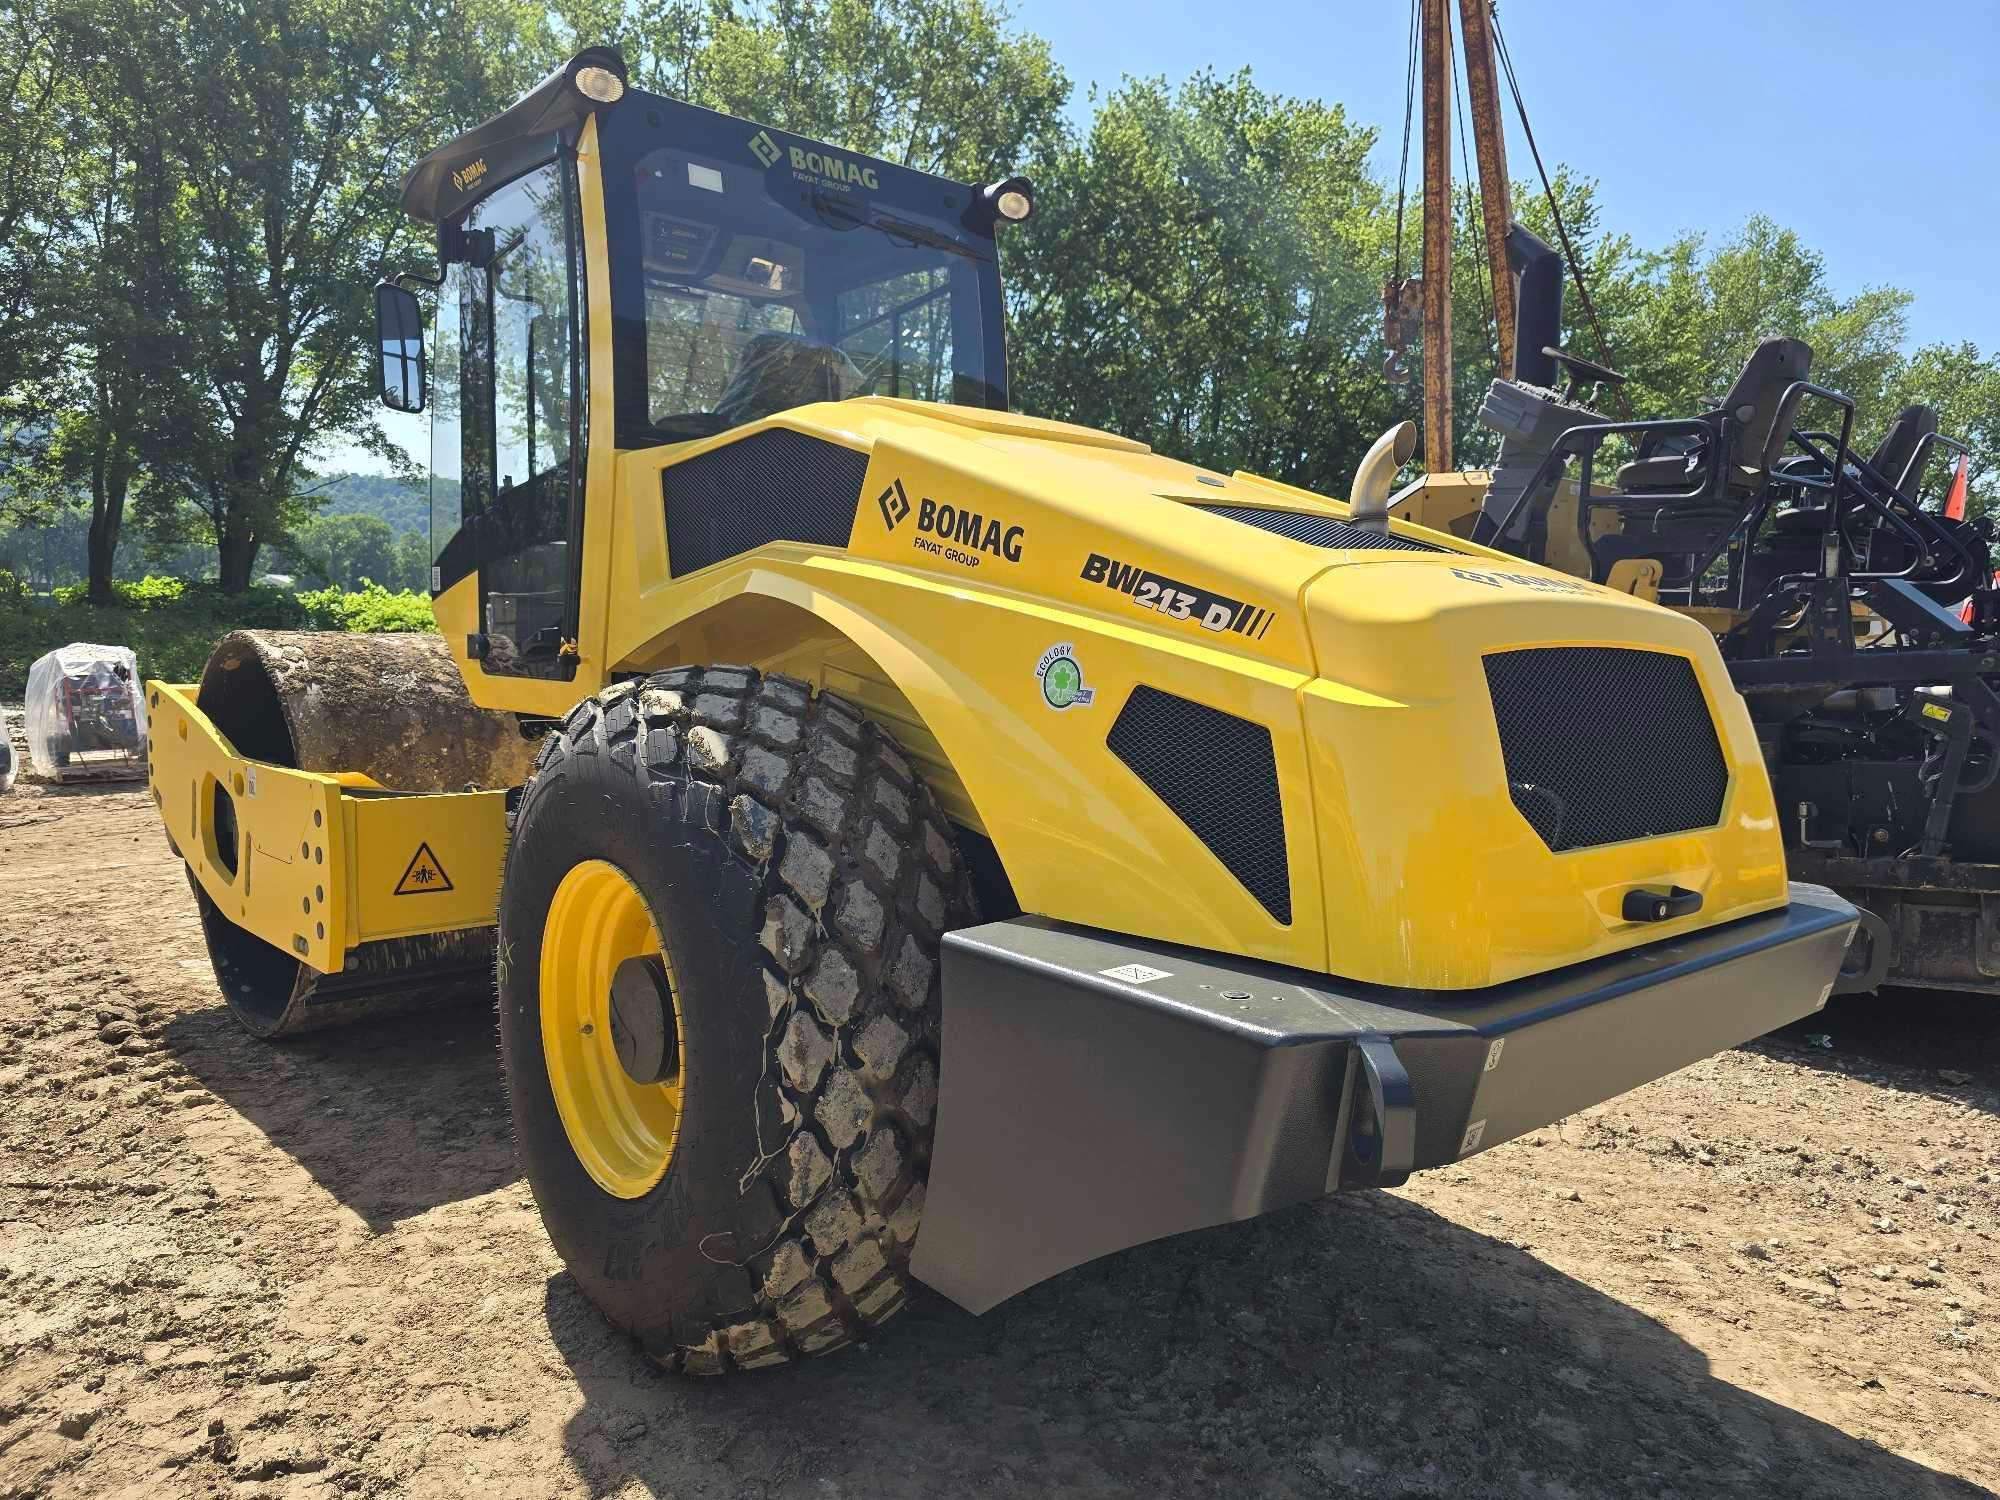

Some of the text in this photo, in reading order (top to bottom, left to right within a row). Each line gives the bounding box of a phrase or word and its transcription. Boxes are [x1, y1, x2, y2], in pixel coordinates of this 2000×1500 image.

[789, 145, 879, 190] BOMAG
[821, 178, 850, 192] GROUP
[918, 498, 1025, 563] BOMAG
[914, 536, 980, 568] FAYAT GROUP
[1037, 645, 1072, 677] ECOLOGY
